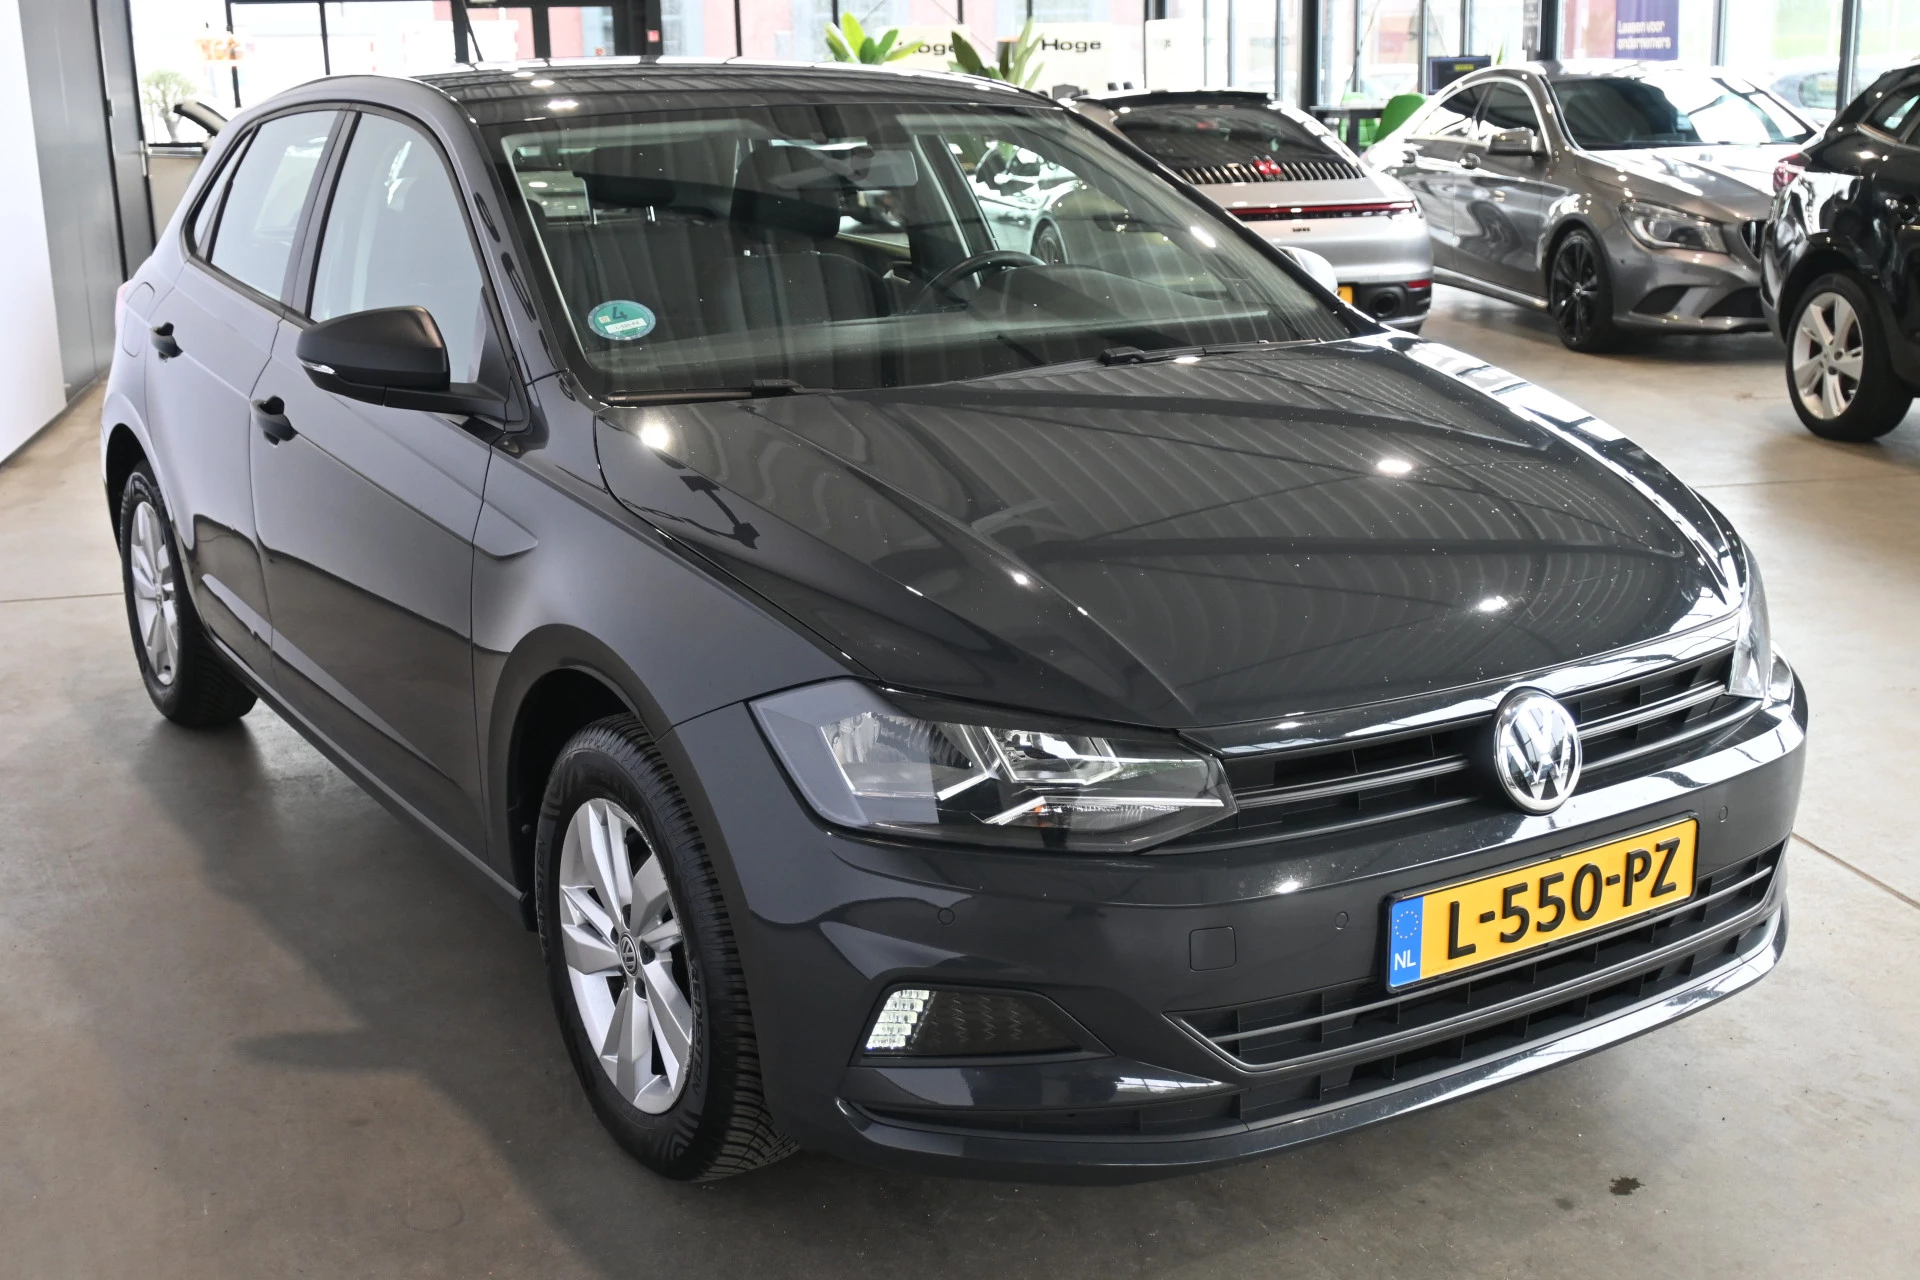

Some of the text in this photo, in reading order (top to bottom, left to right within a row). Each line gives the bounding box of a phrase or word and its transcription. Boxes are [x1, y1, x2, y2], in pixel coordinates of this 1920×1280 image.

[1646, 21, 1665, 33] voor
[1041, 38, 1101, 53] Hoge
[1617, 36, 1671, 50] ondernemers
[612, 305, 628, 320] 4
[1498, 693, 1580, 806] VW
[1448, 837, 1681, 960] L-550-PZ
[1394, 949, 1417, 971] NL
